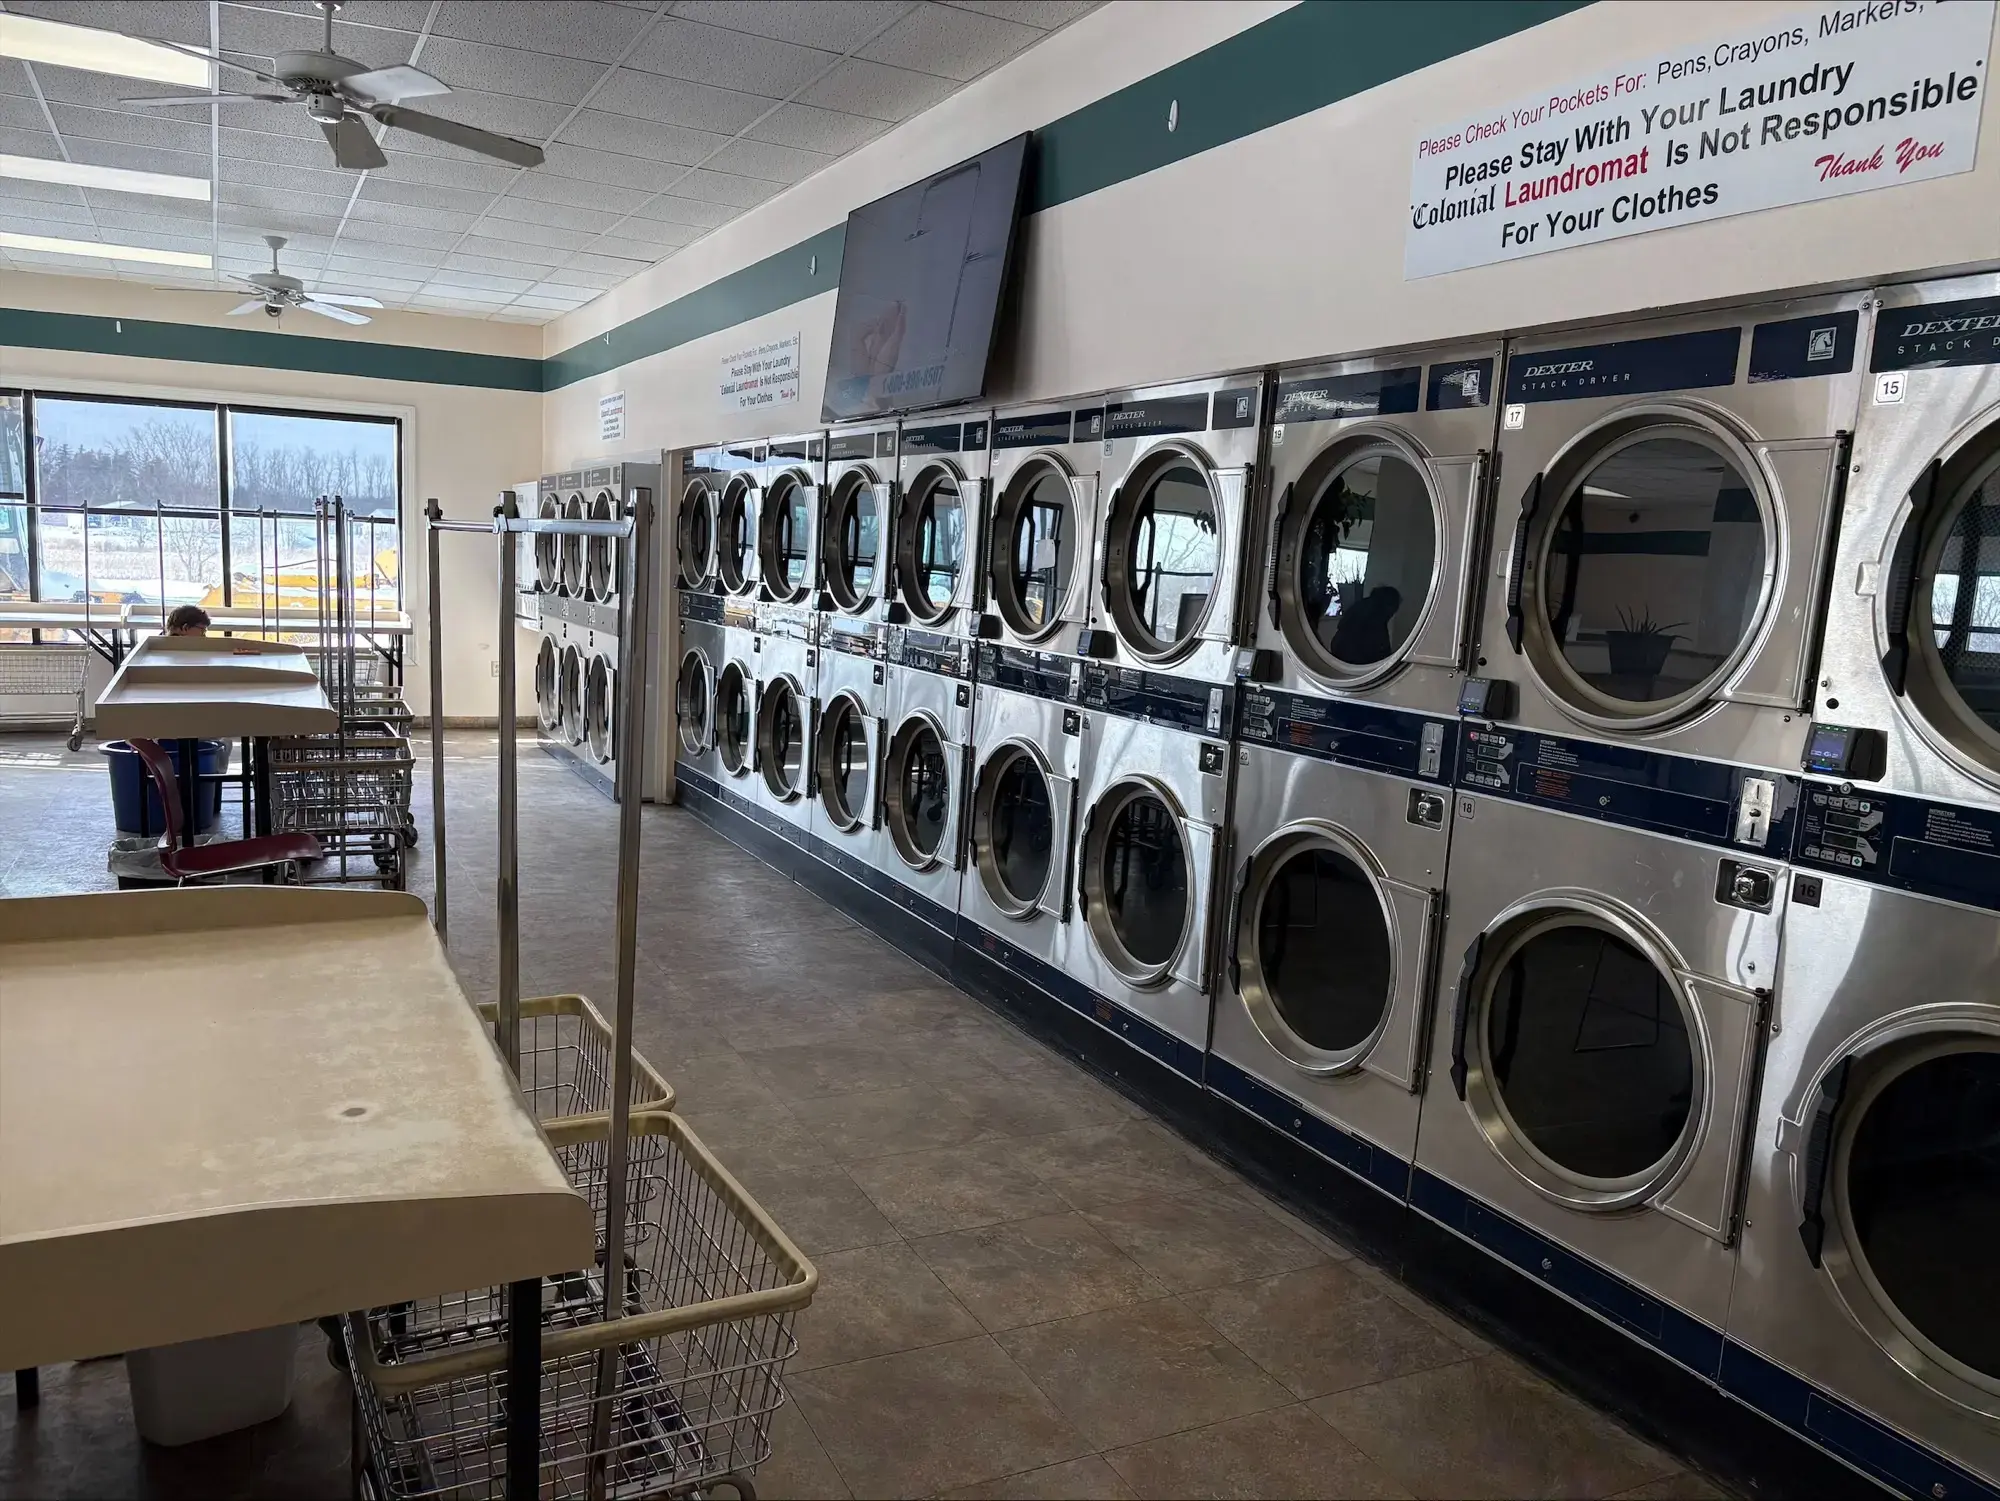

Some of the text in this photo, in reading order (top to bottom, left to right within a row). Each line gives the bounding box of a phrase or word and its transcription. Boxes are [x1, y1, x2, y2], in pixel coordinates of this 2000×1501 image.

[1419, 134, 1461, 159] Please
[1465, 115, 1507, 144] Check
[1512, 102, 1545, 130] Your
[1548, 84, 1609, 118] Pockets
[1614, 70, 1647, 98] For:
[1819, 0, 1924, 38] Markers,
[1445, 61, 1855, 190] Please Stay With Your Laundry
[1412, 71, 1978, 230] Colonial Laundromat Is Not Responsible
[1814, 136, 1945, 183] Thank You
[1501, 180, 1720, 248] For Your Clothes
[1897, 339, 1971, 354] STACK
[762, 359, 772, 371] Your
[773, 354, 791, 368] Laundry
[1524, 360, 1594, 377] DEXTER
[1521, 373, 1631, 391] STACK DRYER
[1883, 381, 1899, 395] 15
[747, 395, 756, 405] Your
[757, 392, 773, 404] Clothes
[1283, 389, 1329, 402] DEXTER
[1112, 410, 1146, 421] DEXTER
[1509, 411, 1521, 423] 17
[999, 425, 1024, 434] DEXTER
[1274, 430, 1282, 439] 19
[1463, 802, 1473, 814] 18
[1800, 883, 1816, 898] 16
